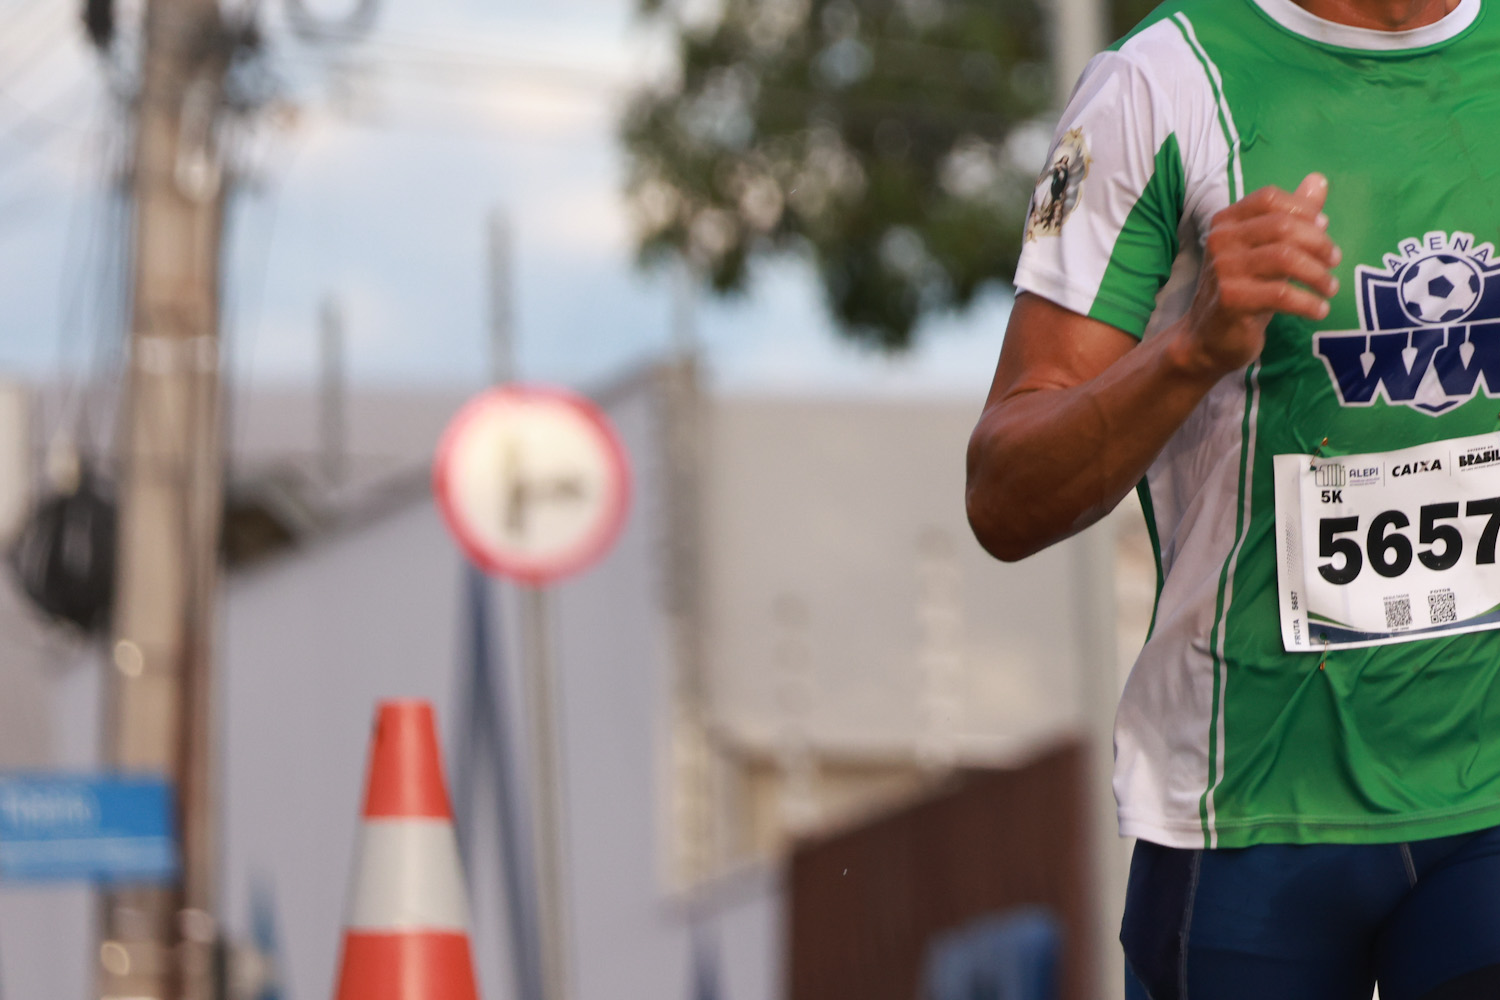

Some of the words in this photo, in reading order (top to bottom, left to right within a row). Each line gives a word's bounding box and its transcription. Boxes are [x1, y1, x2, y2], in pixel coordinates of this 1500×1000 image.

[1388, 236, 1490, 272] ARENA
[1349, 467, 1379, 478] ALEPI
[1391, 459, 1442, 478] CAIXA
[1321, 490, 1343, 504] 5K
[1291, 590, 1299, 611] 5657
[1293, 618, 1301, 646] FRUTA
